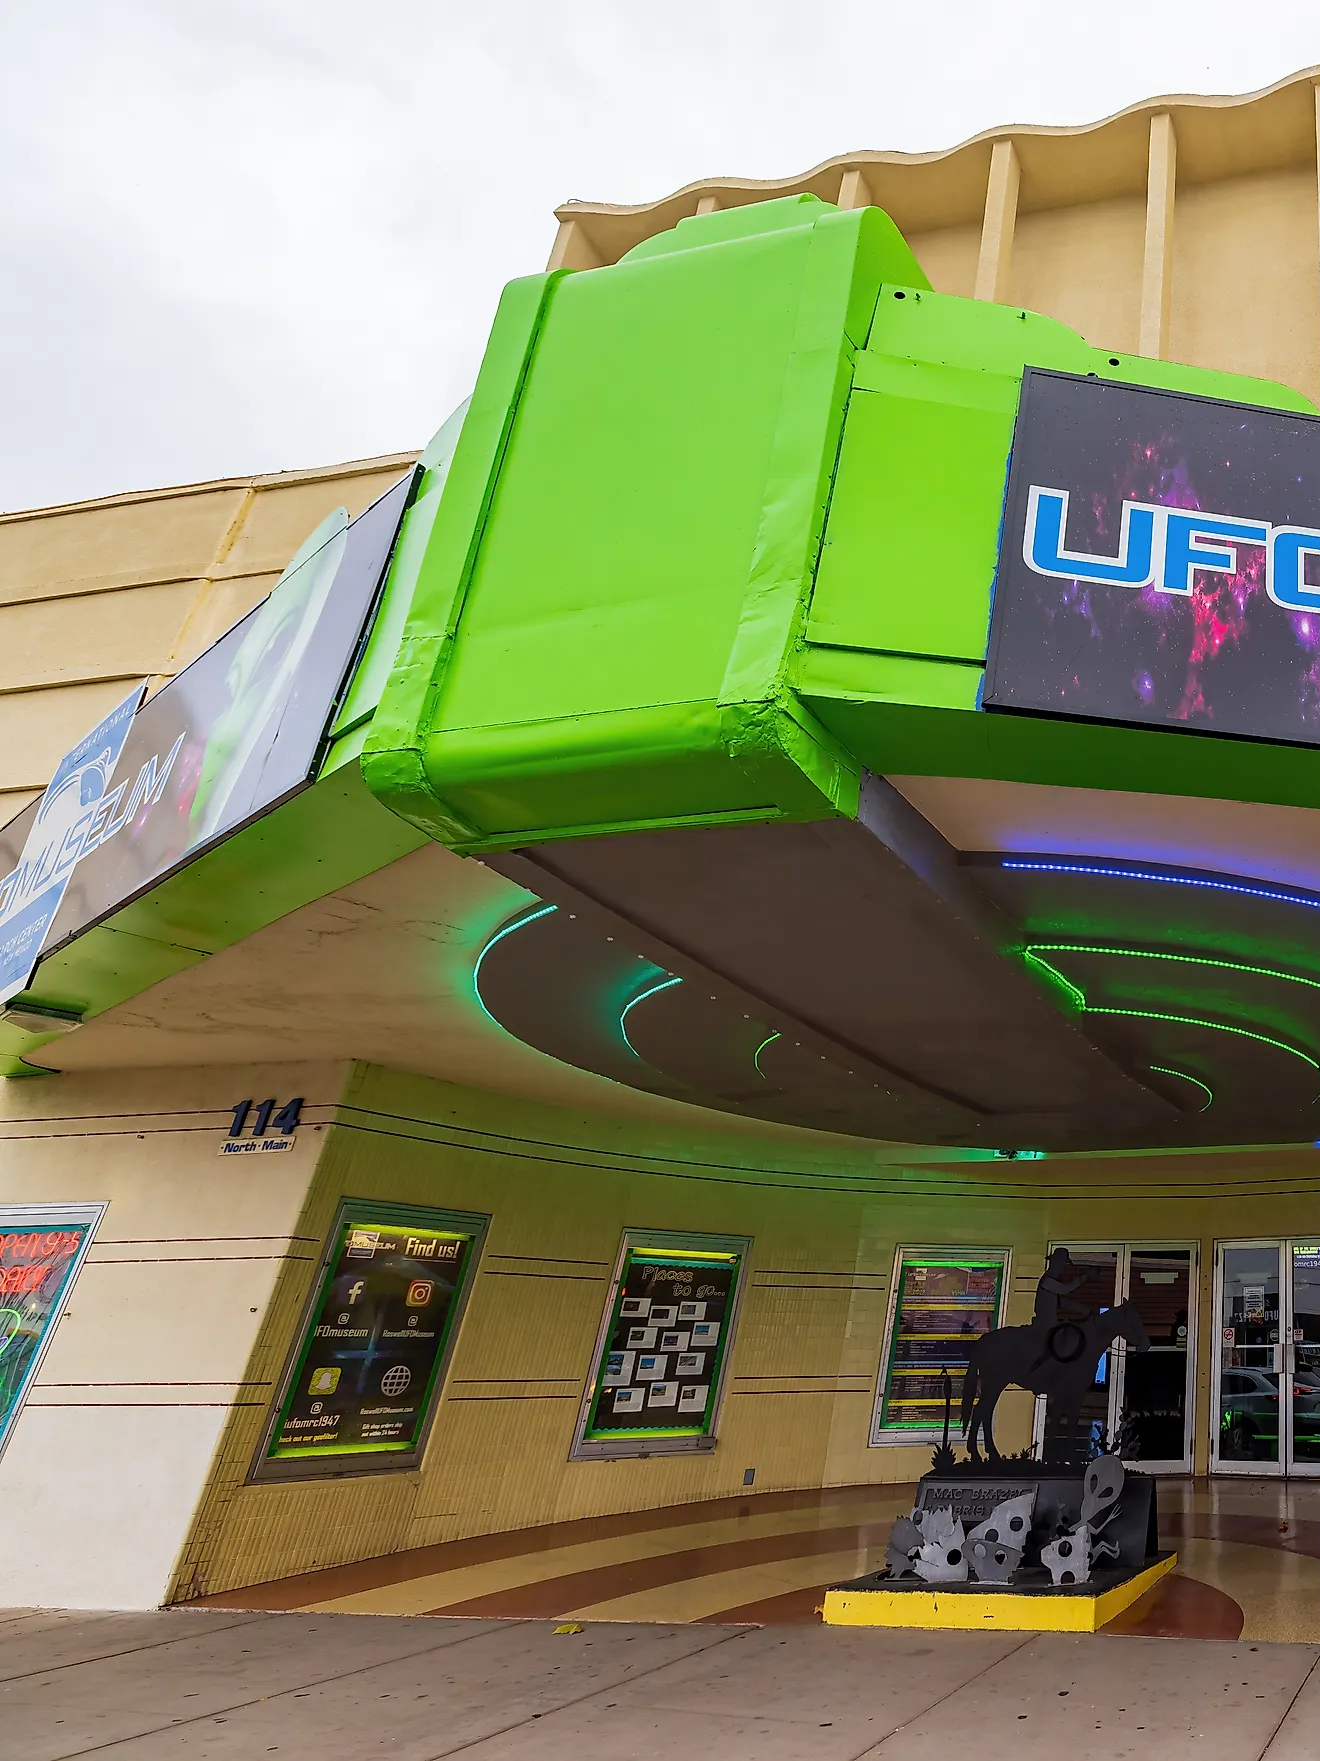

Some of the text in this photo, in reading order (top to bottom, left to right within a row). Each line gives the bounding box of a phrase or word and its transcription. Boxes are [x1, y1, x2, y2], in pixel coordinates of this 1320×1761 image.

[228, 1098, 305, 1137] 114
[224, 1139, 288, 1154] North Main
[0, 1233, 43, 1258] PEN
[405, 1237, 461, 1259] Find us!
[642, 1265, 694, 1283] Places
[672, 1282, 692, 1297] to
[933, 1489, 964, 1500] MAC
